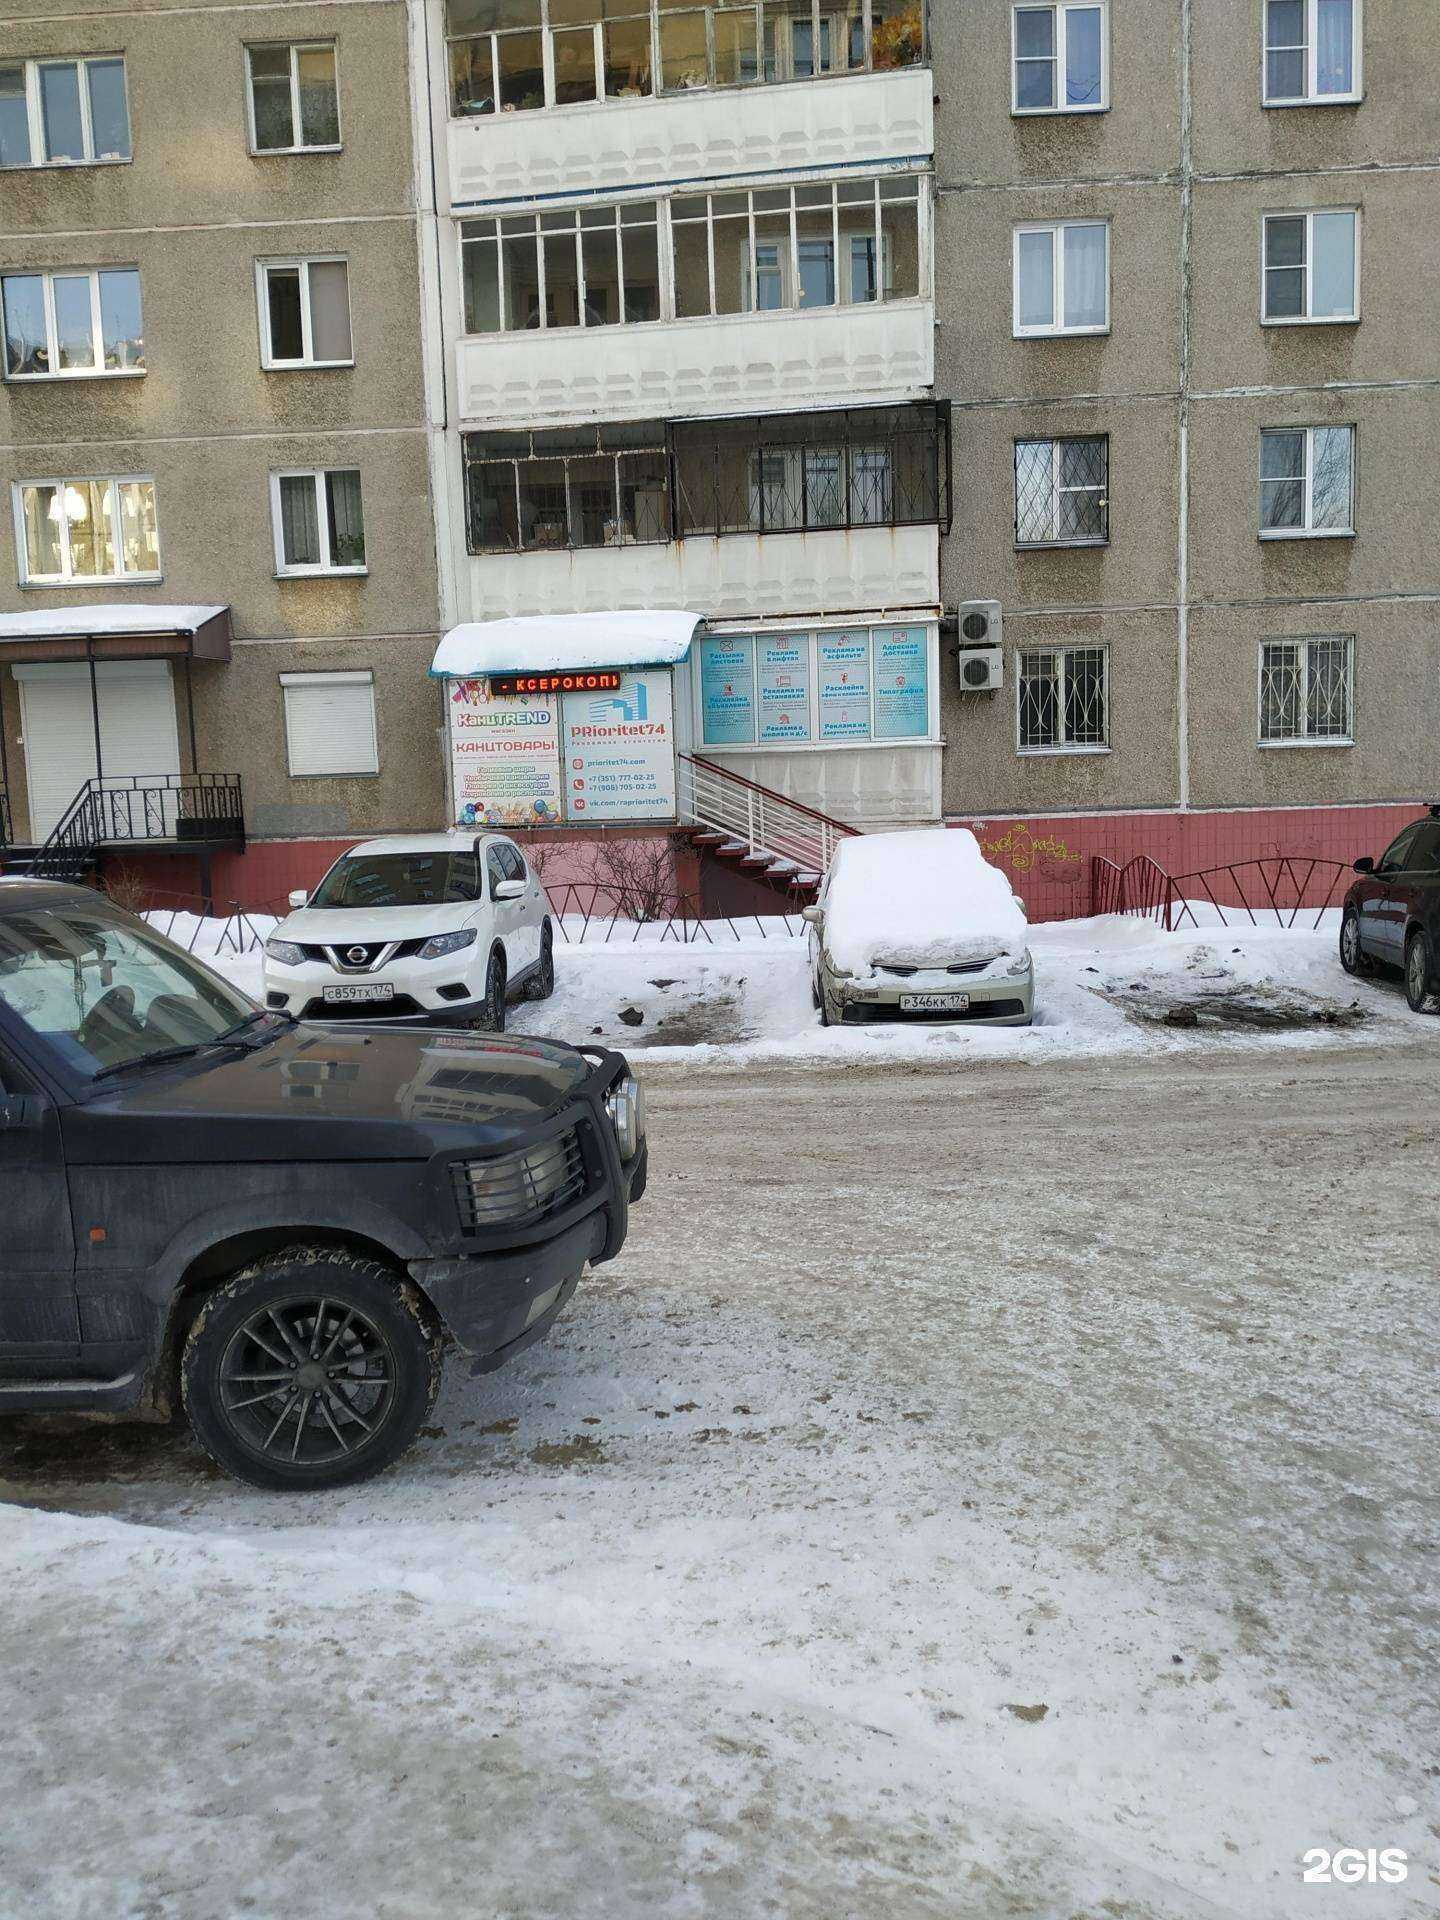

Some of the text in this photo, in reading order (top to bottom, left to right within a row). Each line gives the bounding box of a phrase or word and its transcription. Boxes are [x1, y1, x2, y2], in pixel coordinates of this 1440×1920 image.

[571, 723, 666, 738] PRioritet74
[456, 740, 555, 753] КАНЦТОВАРЫ
[587, 758, 646, 768] prioritet74.com
